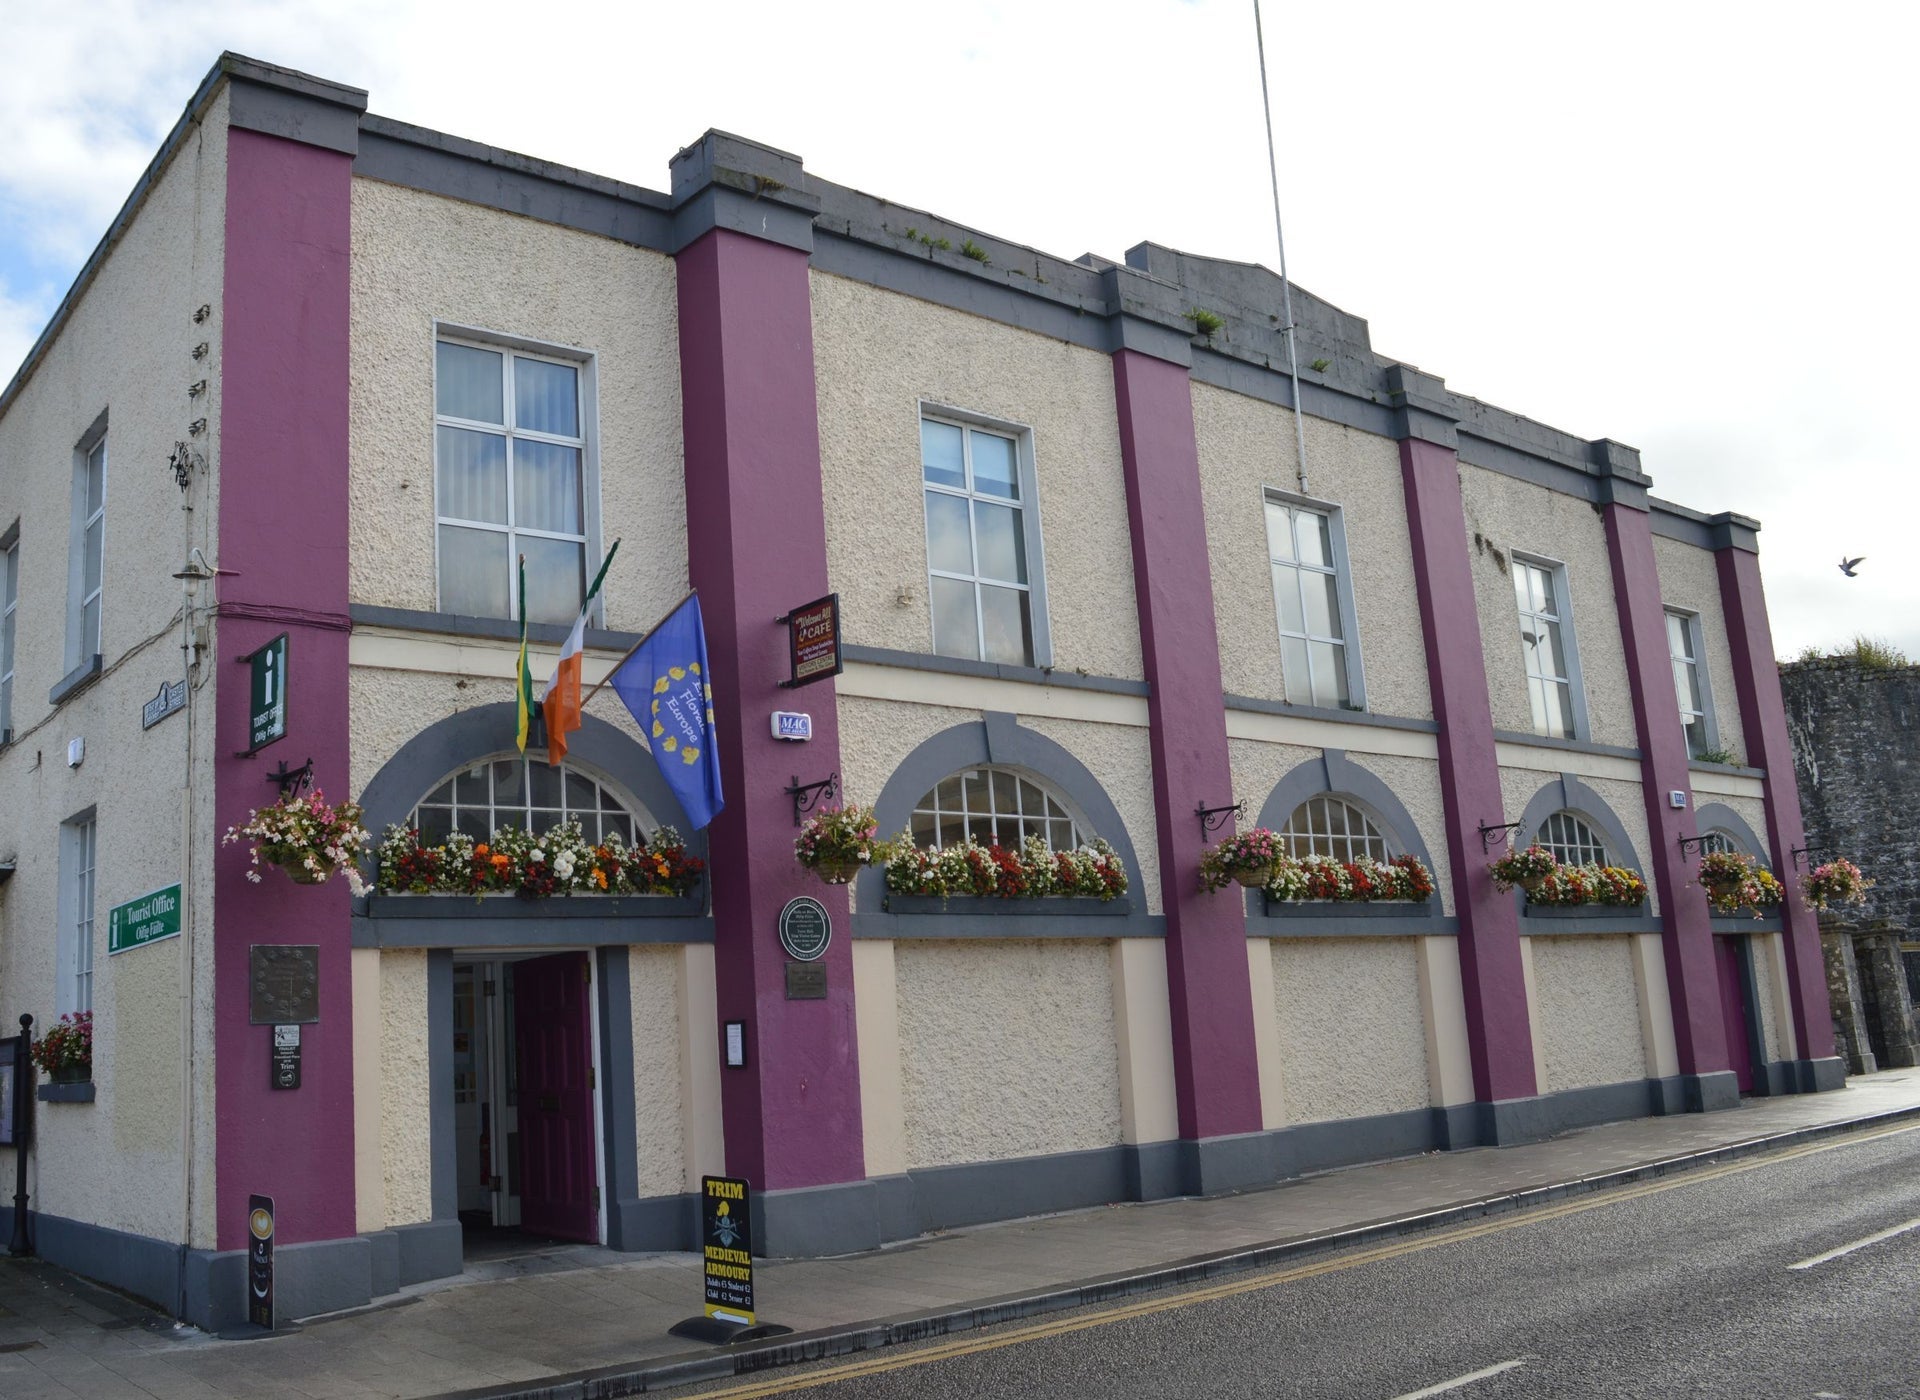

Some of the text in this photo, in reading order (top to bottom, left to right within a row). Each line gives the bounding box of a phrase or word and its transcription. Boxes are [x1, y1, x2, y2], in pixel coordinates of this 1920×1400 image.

[807, 619, 832, 639] CAFÉ
[253, 711, 269, 729] TOURIST
[665, 696, 698, 743] Europe
[781, 717, 807, 729] MAC
[127, 894, 175, 925] Tourist Office
[707, 1181, 744, 1200] TRIM
[705, 1246, 751, 1265] MEDIEVAL
[706, 1262, 750, 1281] ARMOURY
[728, 1281, 744, 1291] Student
[729, 1293, 743, 1303] Senior
